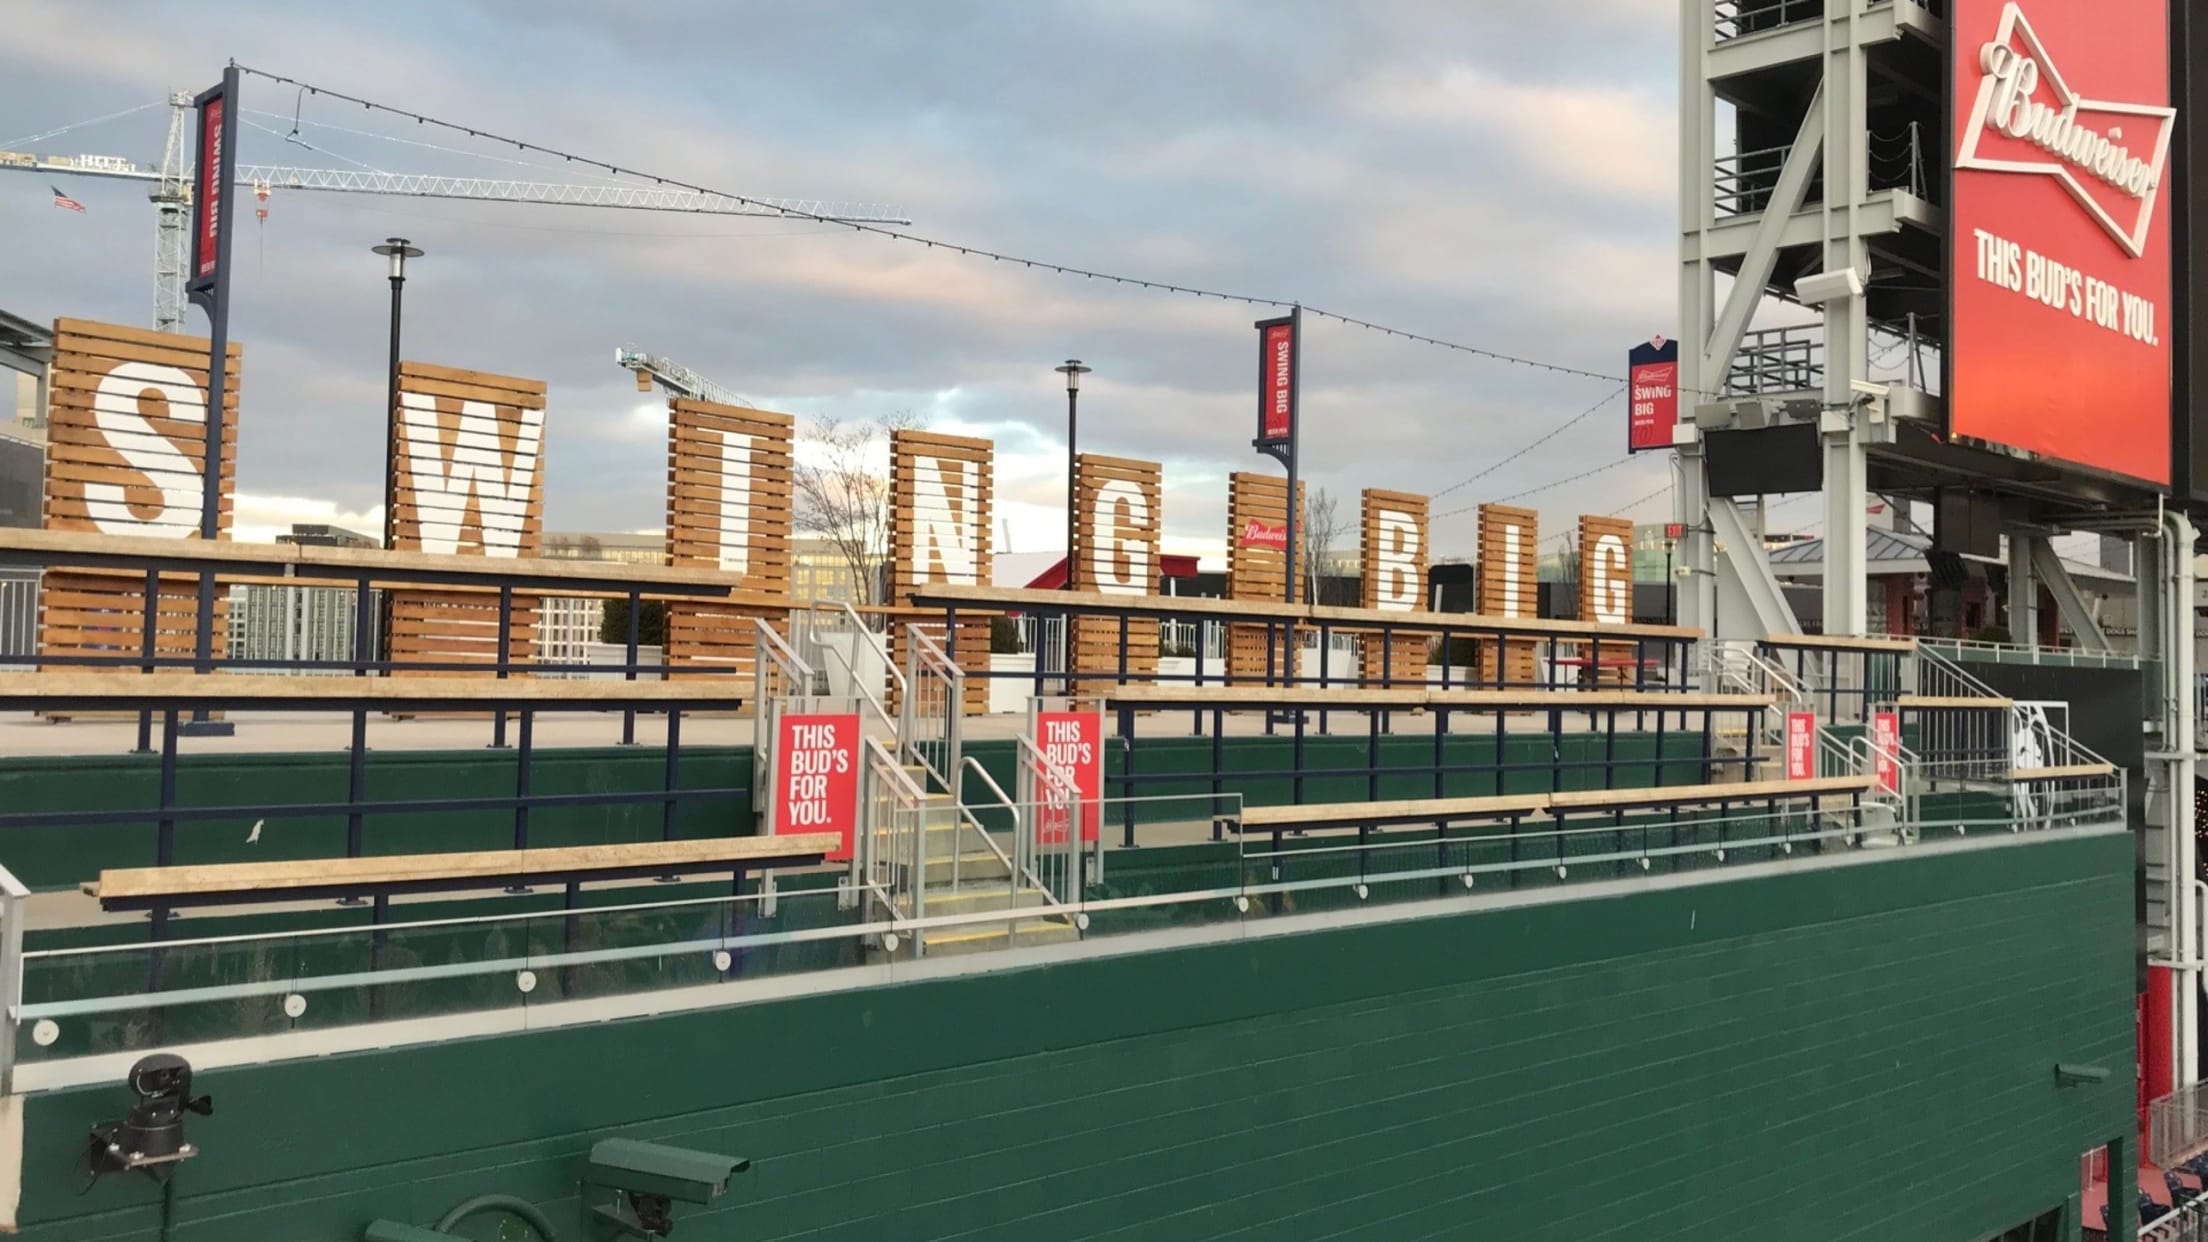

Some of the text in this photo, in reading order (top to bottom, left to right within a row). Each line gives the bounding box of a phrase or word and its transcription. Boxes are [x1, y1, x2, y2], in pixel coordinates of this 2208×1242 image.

[1979, 40, 2157, 198] Budweiser
[1974, 228, 2159, 346] THIS BUD'S FOR YOU.
[1277, 341, 1289, 387] SWING
[1276, 389, 1288, 414] BIG
[1634, 385, 1672, 400] SWING
[1634, 402, 1655, 416] BIG
[791, 724, 836, 749] THIS
[1045, 721, 1080, 742] THIS
[791, 749, 849, 775] BUD'S
[1045, 742, 1091, 765] BUD'S
[789, 775, 827, 800] FOR
[788, 800, 832, 826] YOU.
